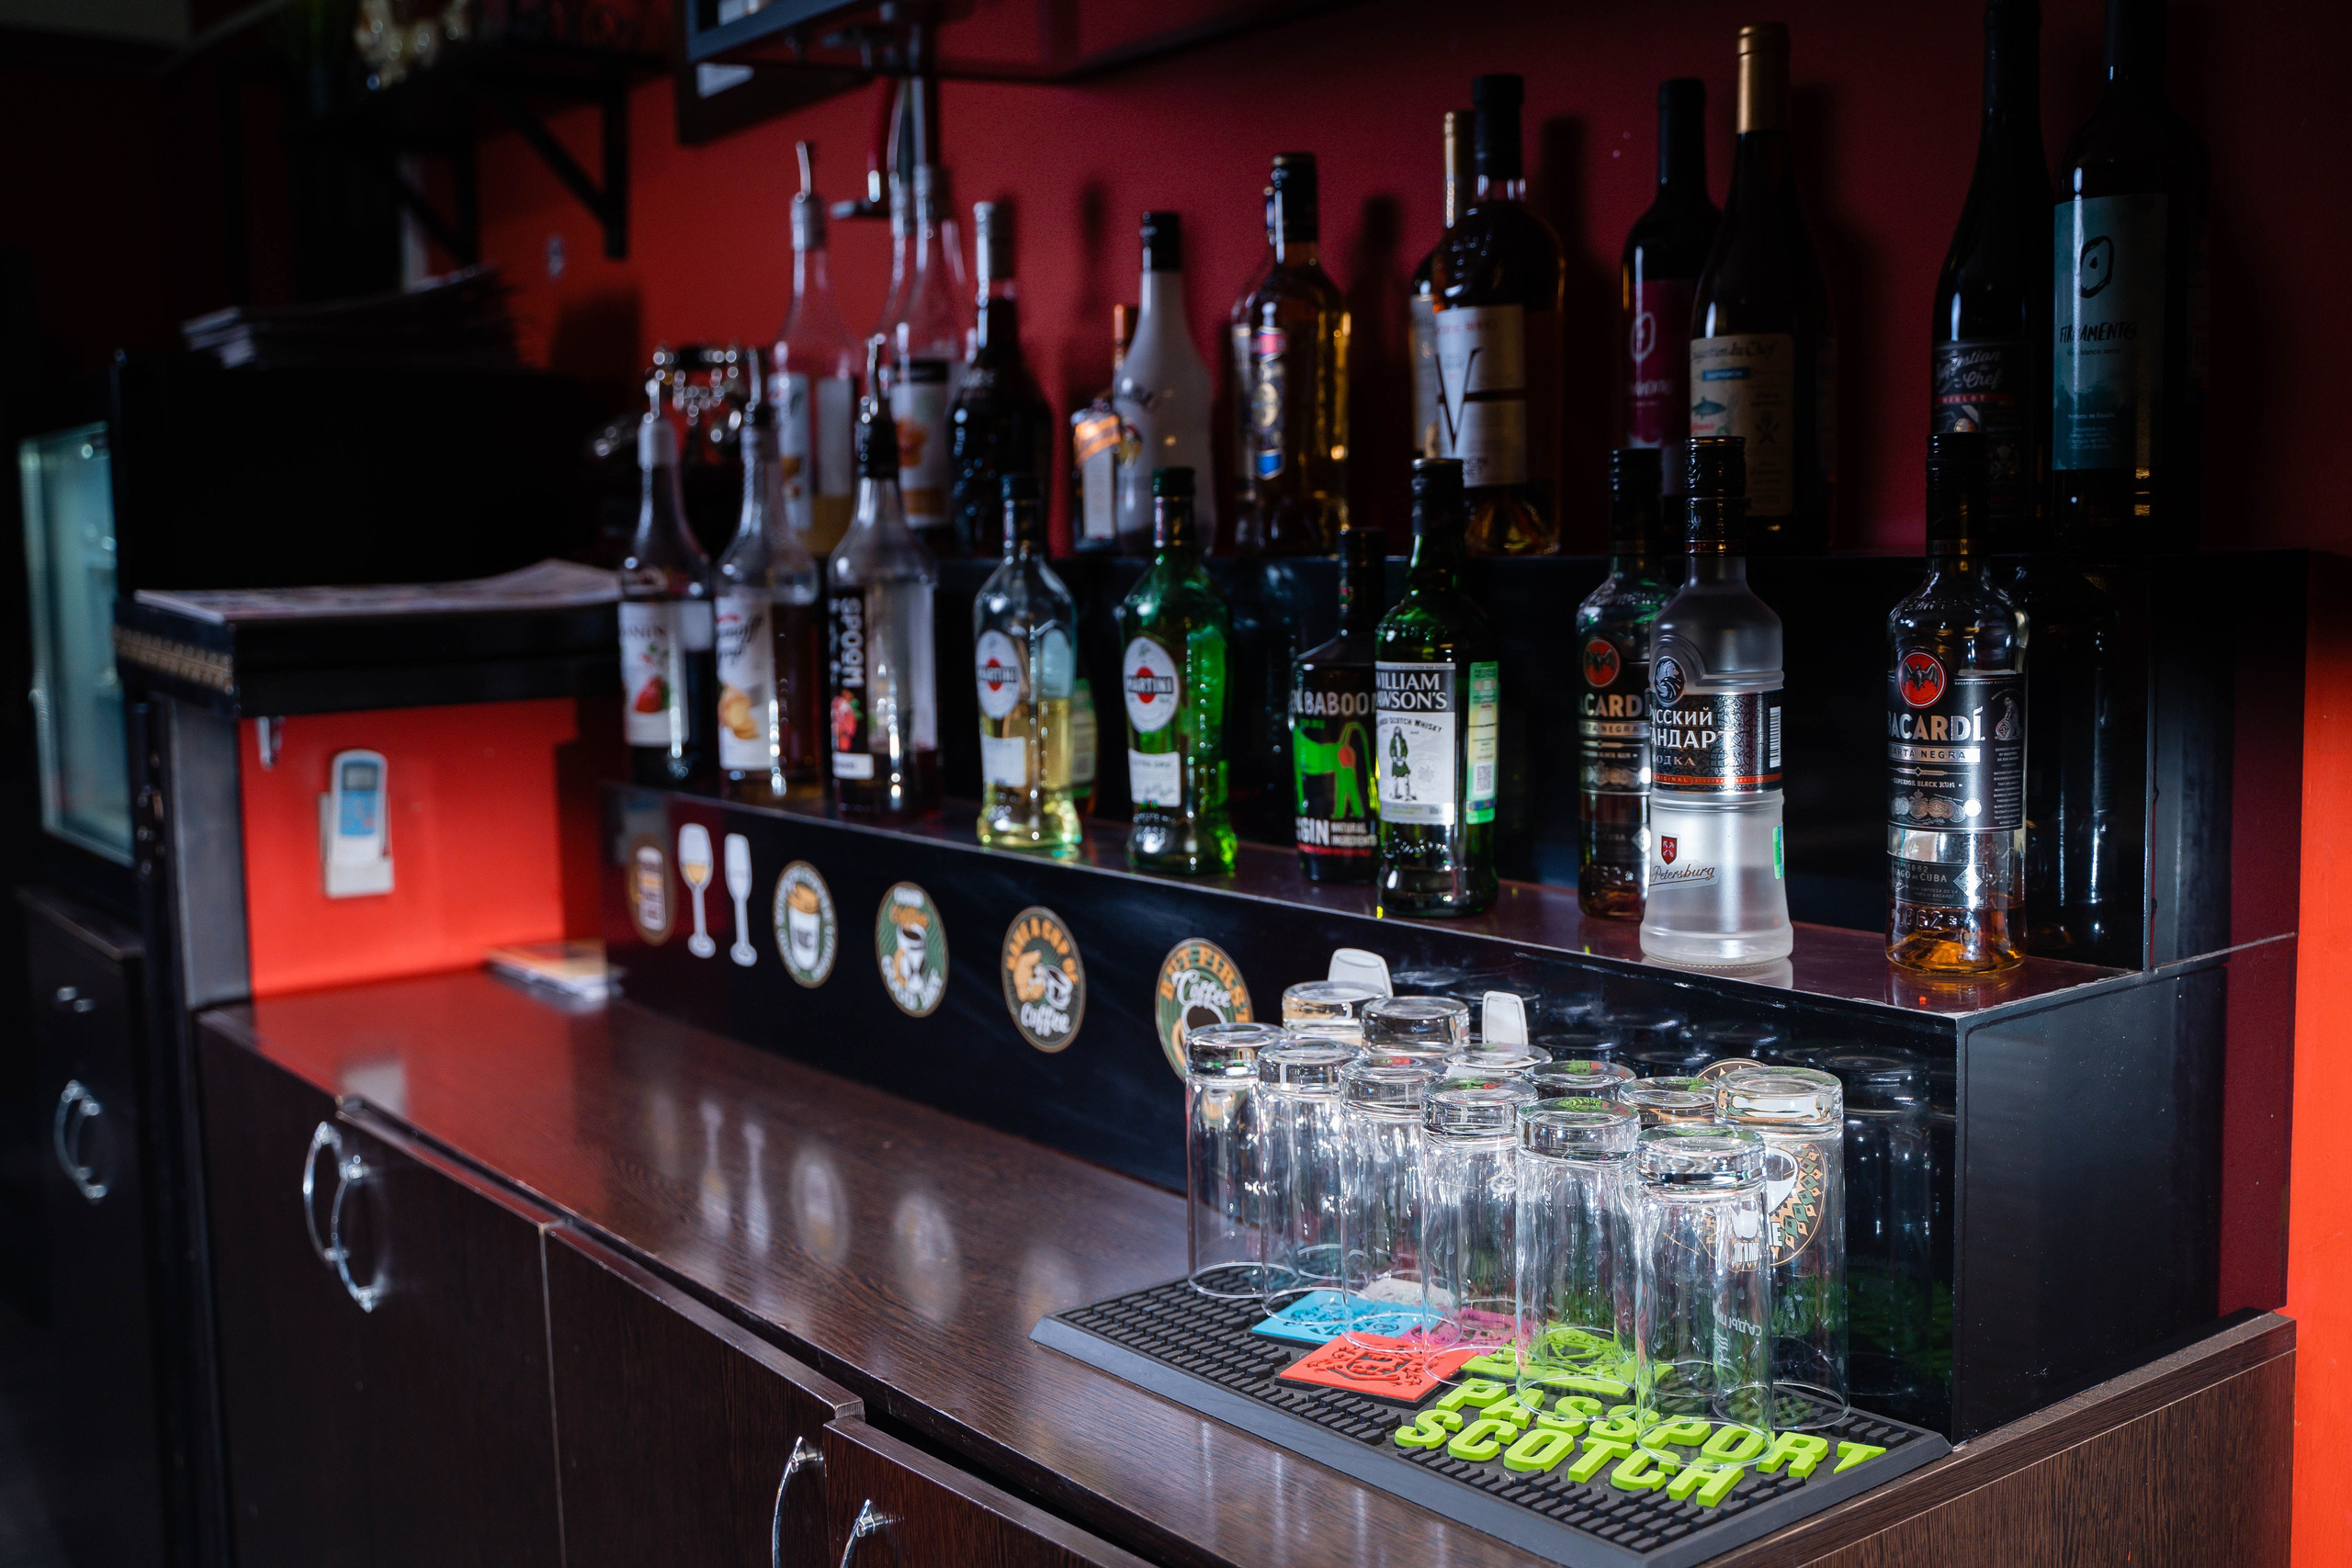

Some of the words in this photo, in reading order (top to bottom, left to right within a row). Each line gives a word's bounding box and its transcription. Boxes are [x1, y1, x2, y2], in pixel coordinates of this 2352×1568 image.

[2059, 321, 2137, 344] FIRAMENTO
[1962, 367, 2005, 390] Chef
[1941, 393, 1988, 405] MERLOT
[1920, 750, 1966, 760] NEGRA
[1300, 817, 1330, 846] GIN
[1651, 863, 1715, 882] Petersburg
[1919, 873, 1948, 884] CUBA
[1159, 947, 1192, 1002] BUT
[1198, 946, 1250, 1023] FIRST
[1171, 968, 1231, 1009] Coffee
[1020, 1001, 1071, 1037] Coffee
[1435, 1378, 1887, 1480] PASSPORT
[1394, 1408, 1745, 1508] SCOTCH
